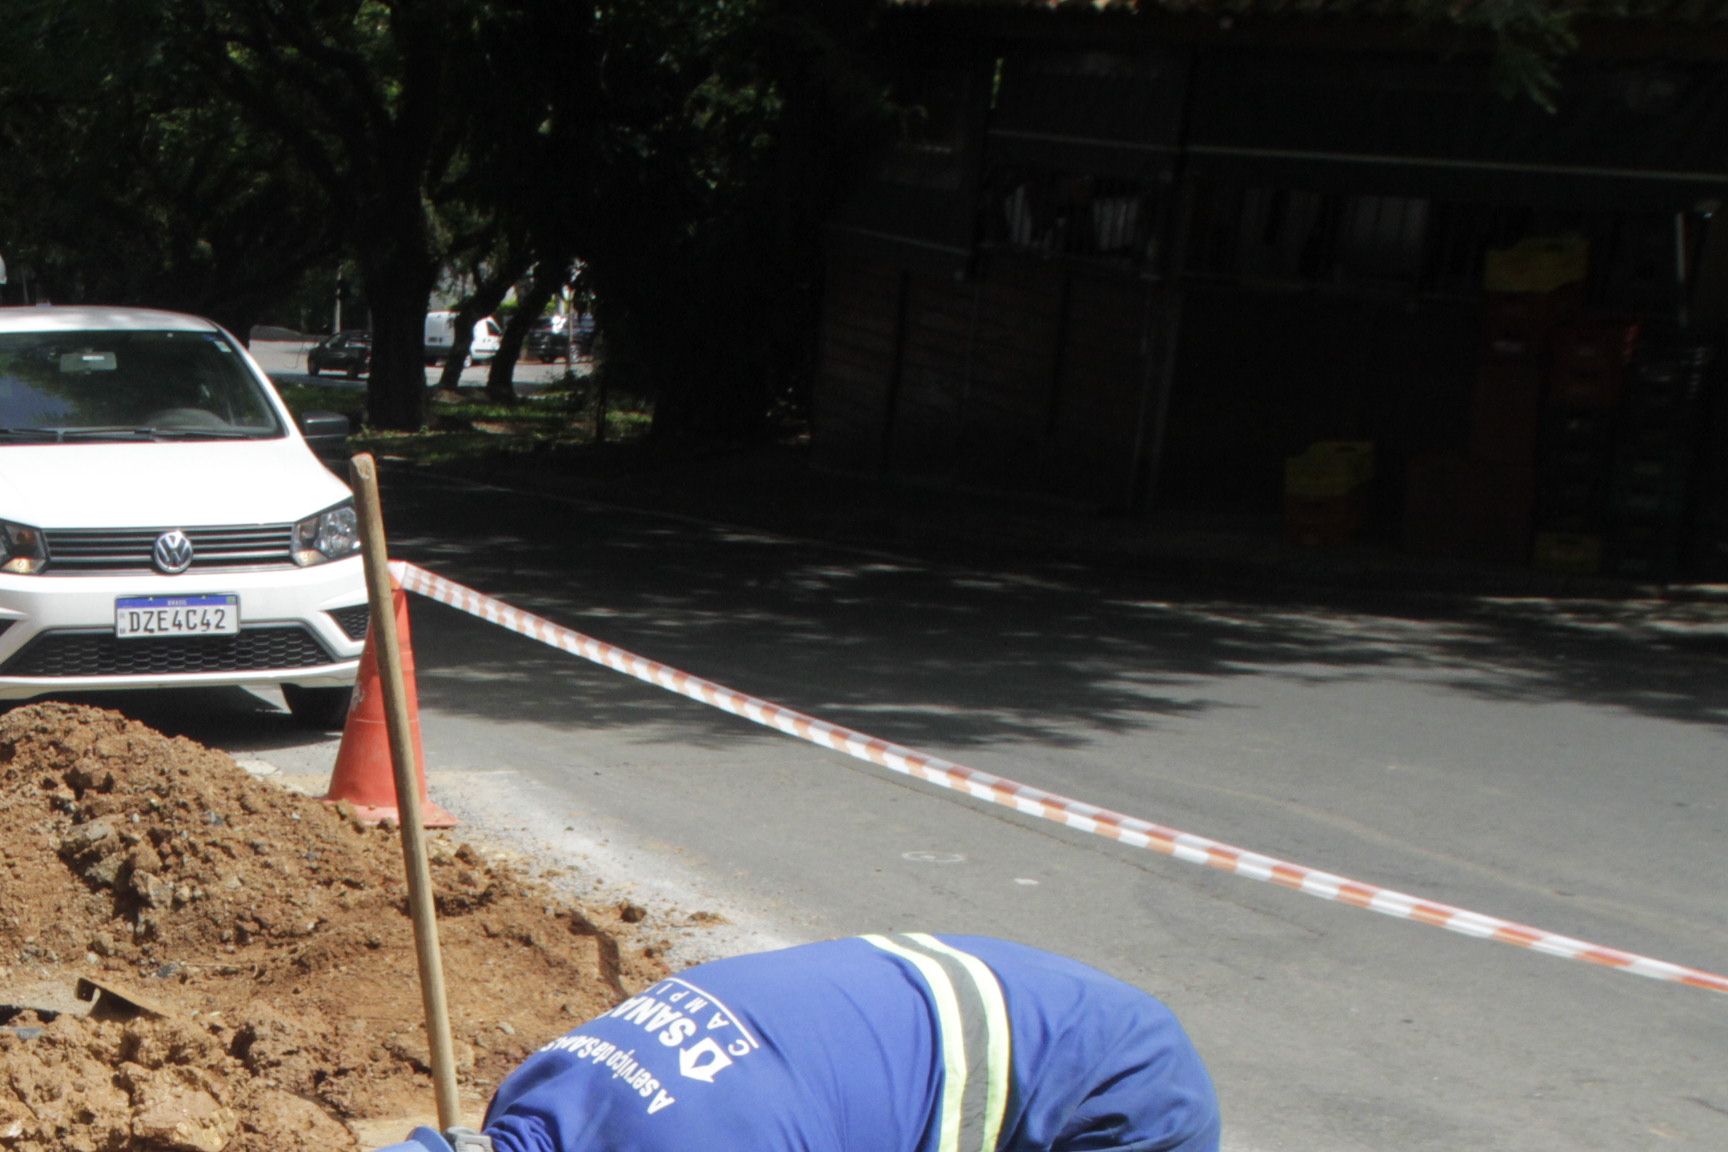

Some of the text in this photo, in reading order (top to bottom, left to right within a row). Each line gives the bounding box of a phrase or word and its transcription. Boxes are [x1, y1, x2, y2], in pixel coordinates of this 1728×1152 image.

[128, 608, 226, 634] DZE4C42
[596, 996, 697, 1047] SANA
[647, 1088, 676, 1115] A
